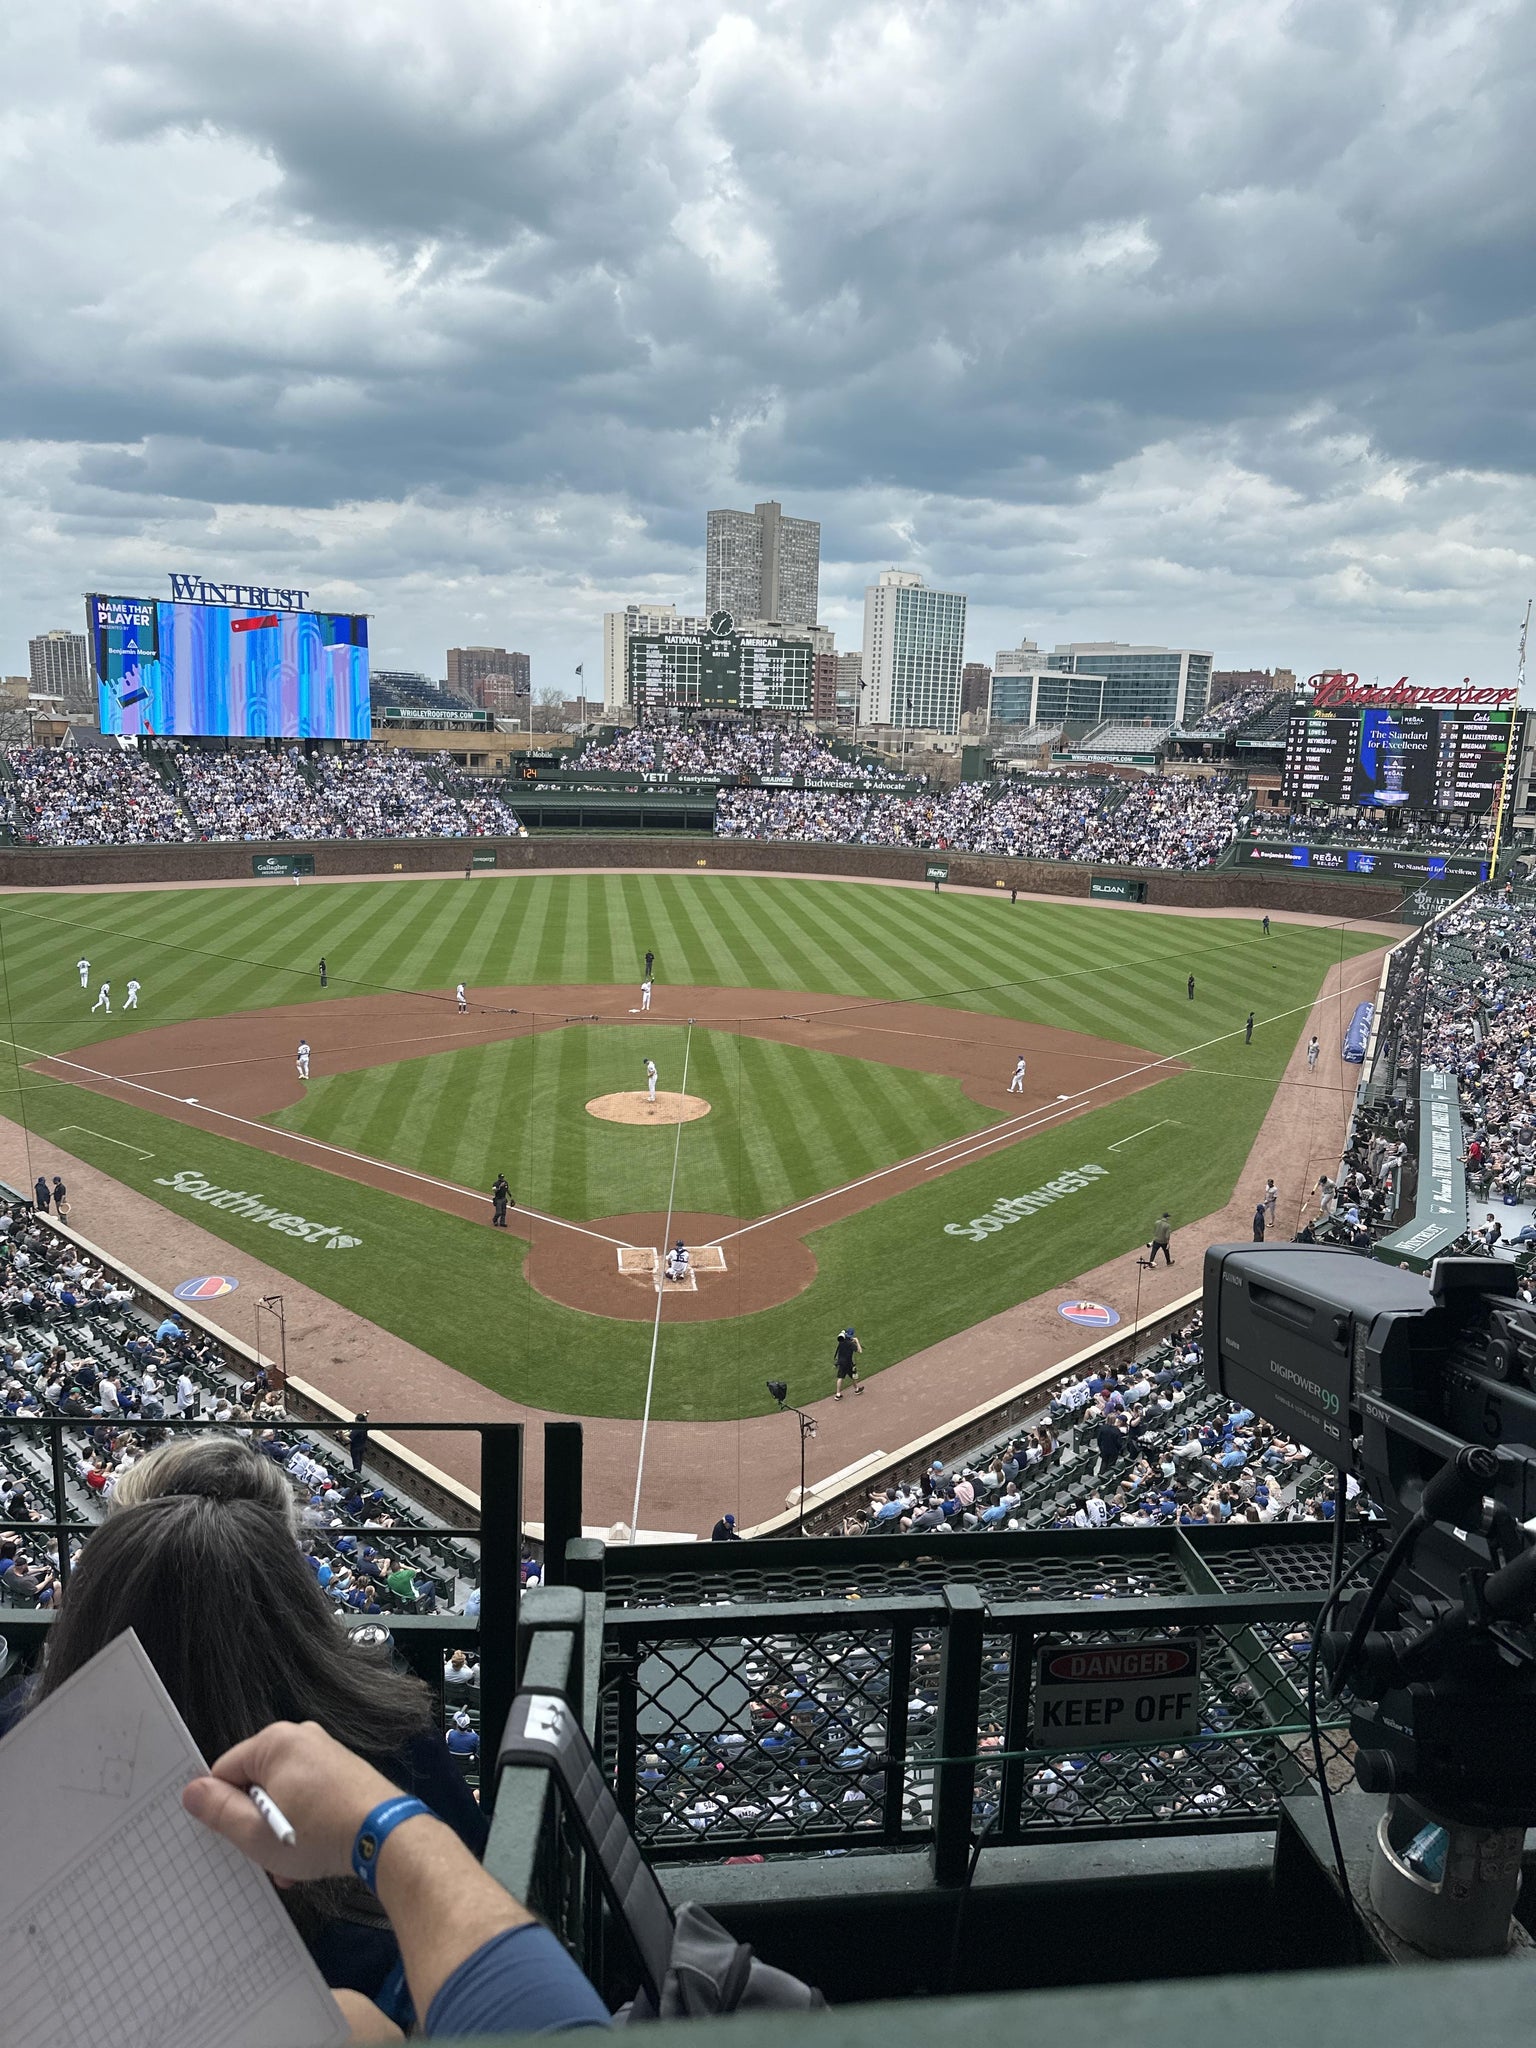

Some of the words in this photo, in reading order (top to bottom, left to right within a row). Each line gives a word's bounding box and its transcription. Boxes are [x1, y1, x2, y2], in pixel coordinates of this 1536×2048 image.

[168, 573, 309, 609] WINTRUST
[97, 603, 127, 612] NAME
[128, 605, 153, 614] THAT
[98, 612, 150, 626] PLAYER
[664, 636, 702, 645] NATIONAL
[740, 639, 778, 647] AMERICAN
[1308, 673, 1518, 706] Budweiser
[400, 709, 473, 719] WRIGLEYROOFTOPS.COM
[1314, 710, 1336, 718] Pirates
[1473, 712, 1490, 722] Cubs
[1370, 730, 1386, 739] The
[1388, 731, 1428, 740] Standard
[1368, 740, 1380, 748] for
[1382, 741, 1428, 750] Excellence
[641, 773, 668, 782] YETI
[804, 778, 854, 788] Budweiser
[873, 782, 905, 790] Advocate
[1313, 853, 1344, 862] REGAL
[1393, 862, 1405, 870] The
[1406, 864, 1433, 872] Standard
[1444, 867, 1477, 876] Excellence
[1092, 884, 1124, 894] SLOAN
[1414, 894, 1454, 904] DRAFT
[152, 1171, 343, 1243] Southwest
[944, 1170, 1099, 1242] Southwest
[1394, 1224, 1443, 1251] WINTRUST
[676, 1254, 685, 1262] 15
[1366, 1403, 1391, 1423] SONY
[1482, 1394, 1502, 1438] 5
[1323, 1420, 1340, 1439] HD
[1098, 1506, 1105, 1518] 9
[1071, 1652, 1168, 1677] DANGER
[1042, 1697, 1124, 1728] KEEP
[1134, 1692, 1192, 1723] OFF
